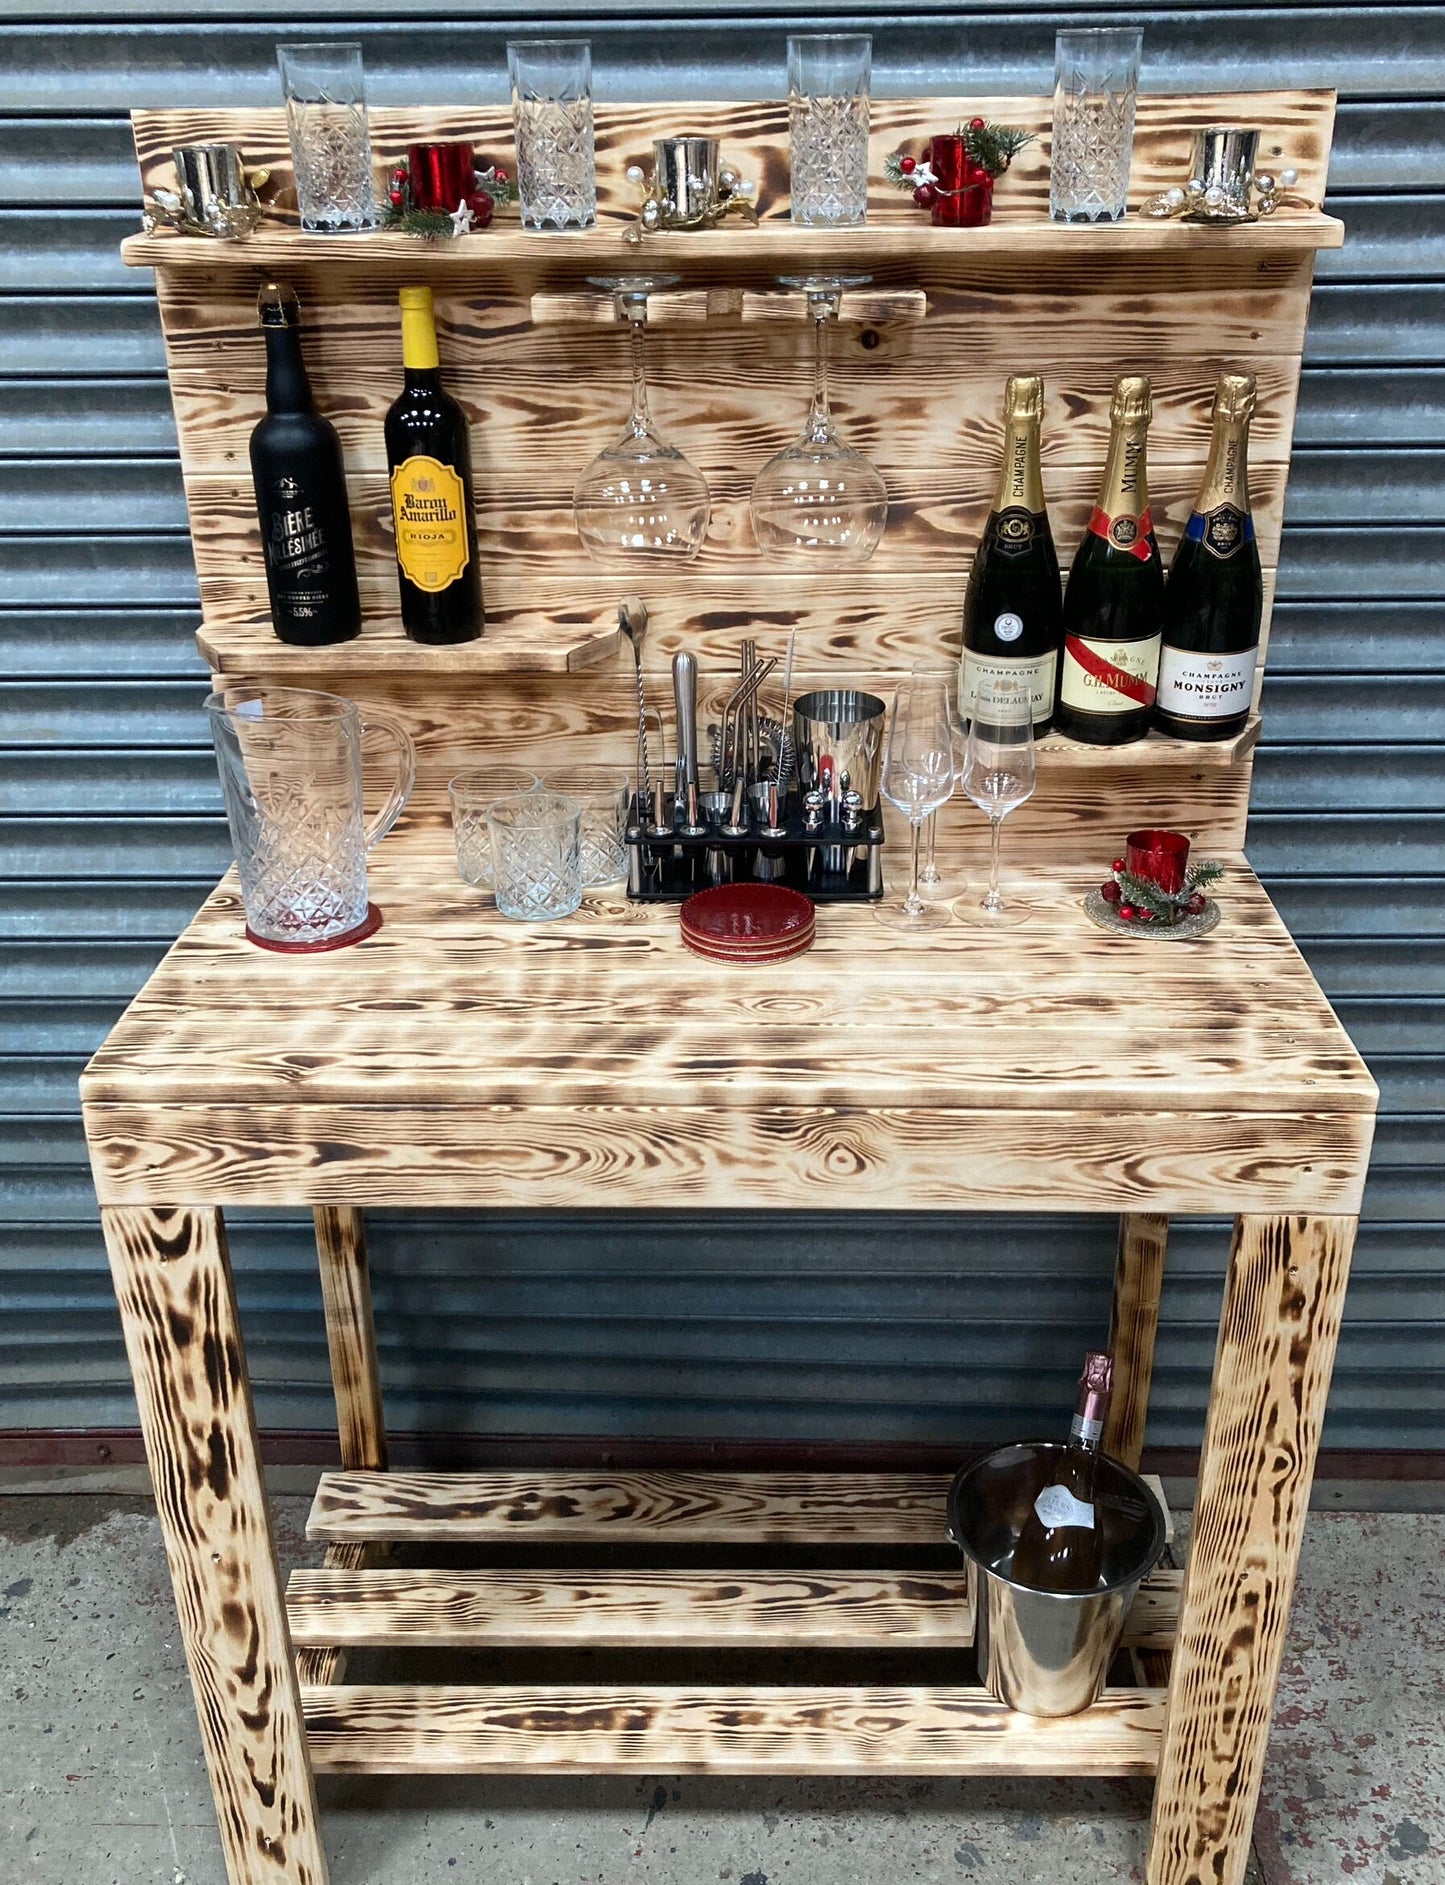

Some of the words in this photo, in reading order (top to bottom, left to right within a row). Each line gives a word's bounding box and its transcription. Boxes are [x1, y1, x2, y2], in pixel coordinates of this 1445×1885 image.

[1013, 436, 1028, 497] CHAMPAGNE
[1121, 442, 1142, 493] MUMM
[1224, 438, 1239, 494] CHAMPAGNE
[404, 493, 448, 509] Baron
[400, 505, 457, 522] Amarillo
[271, 506, 314, 542] BIÈRE
[976, 666, 1040, 676] CHAMPAGNE
[1182, 670, 1242, 679] CHAMPAGNE
[1173, 680, 1247, 693] MONSIGNY
